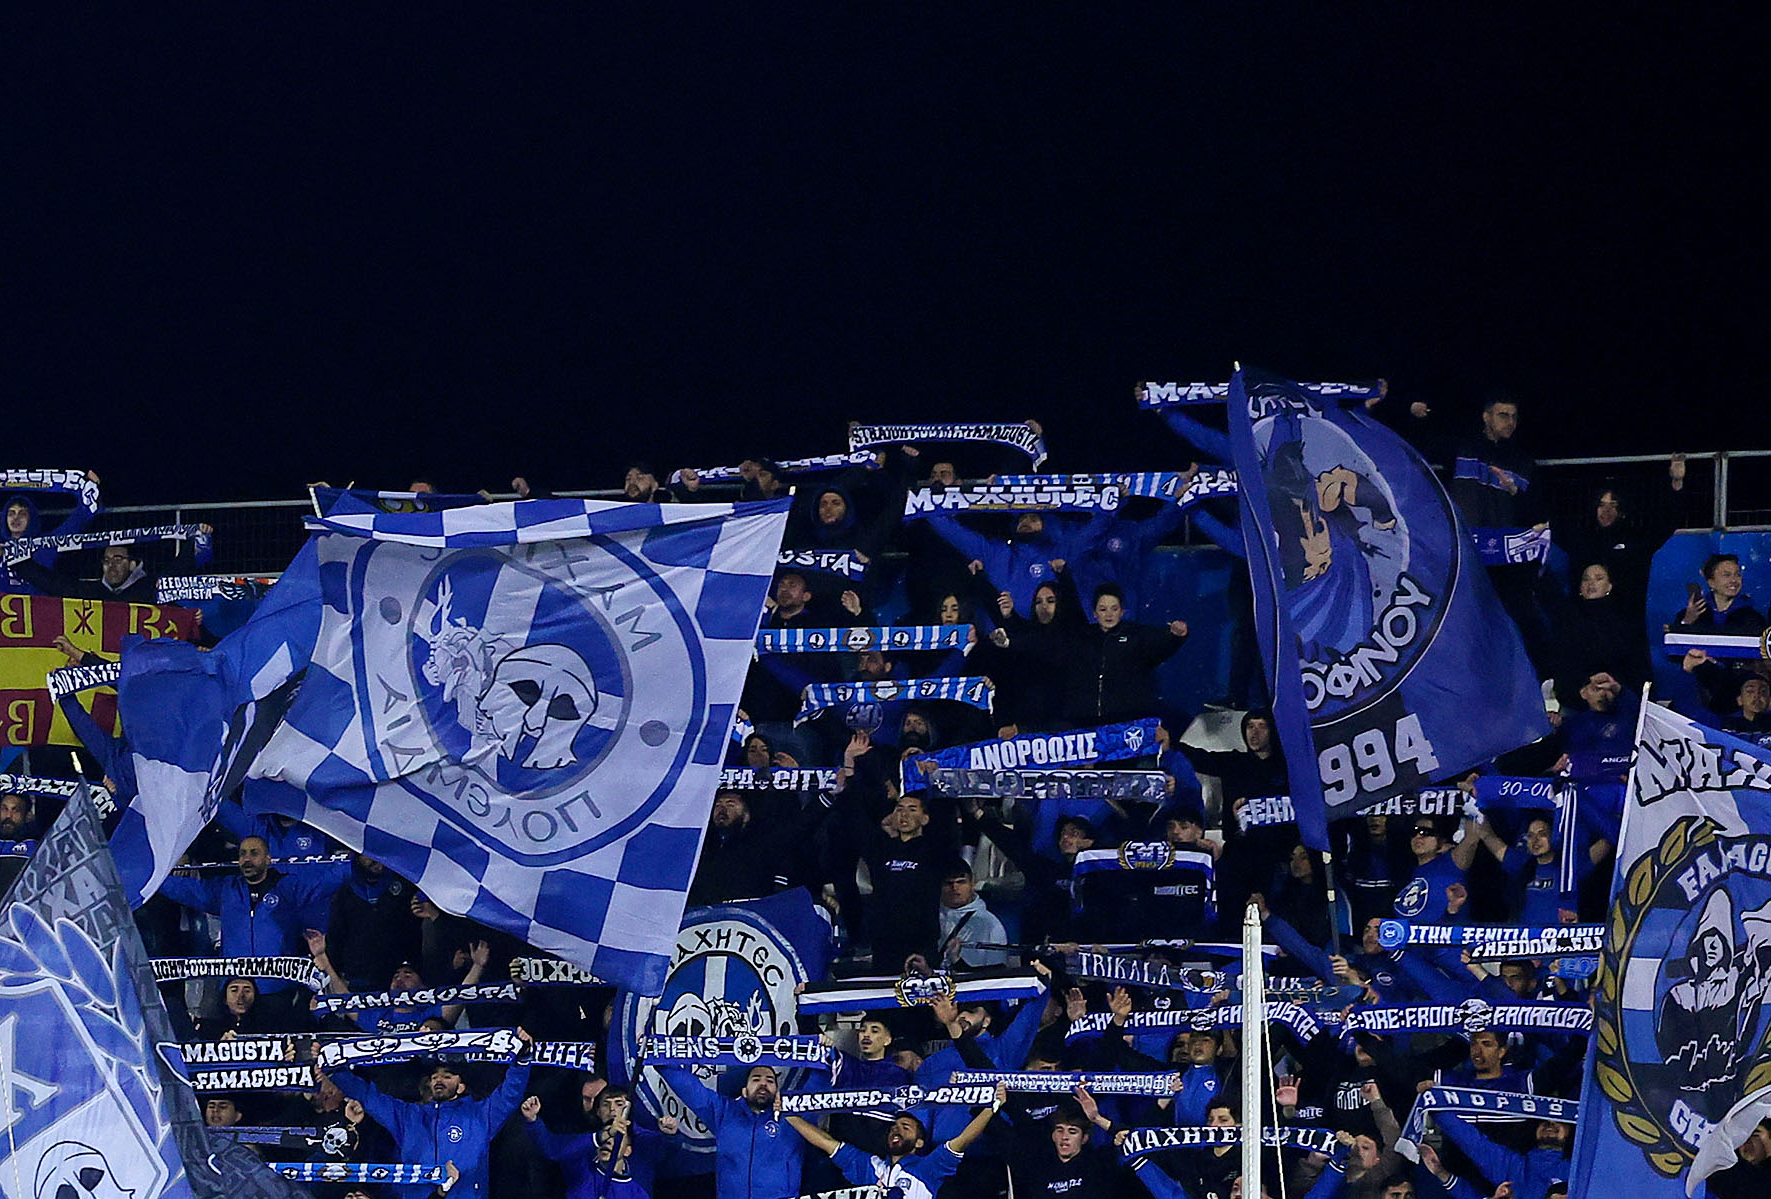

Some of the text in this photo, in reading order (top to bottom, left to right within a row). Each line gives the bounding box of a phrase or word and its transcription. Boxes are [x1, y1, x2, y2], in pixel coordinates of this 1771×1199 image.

[971, 732, 1098, 769] ΑΝΟΡΘΩΣΙΣ
[1408, 926, 1453, 944] ΣΤΗΝ
[1078, 951, 1172, 985] TRIKALA
[184, 1041, 285, 1063] MAGUSTA
[196, 1066, 315, 1090] FAMAGUSTA
[937, 1086, 995, 1104] CLUB
[1122, 1126, 1243, 1156] ΜΑΧΗΤΕ
